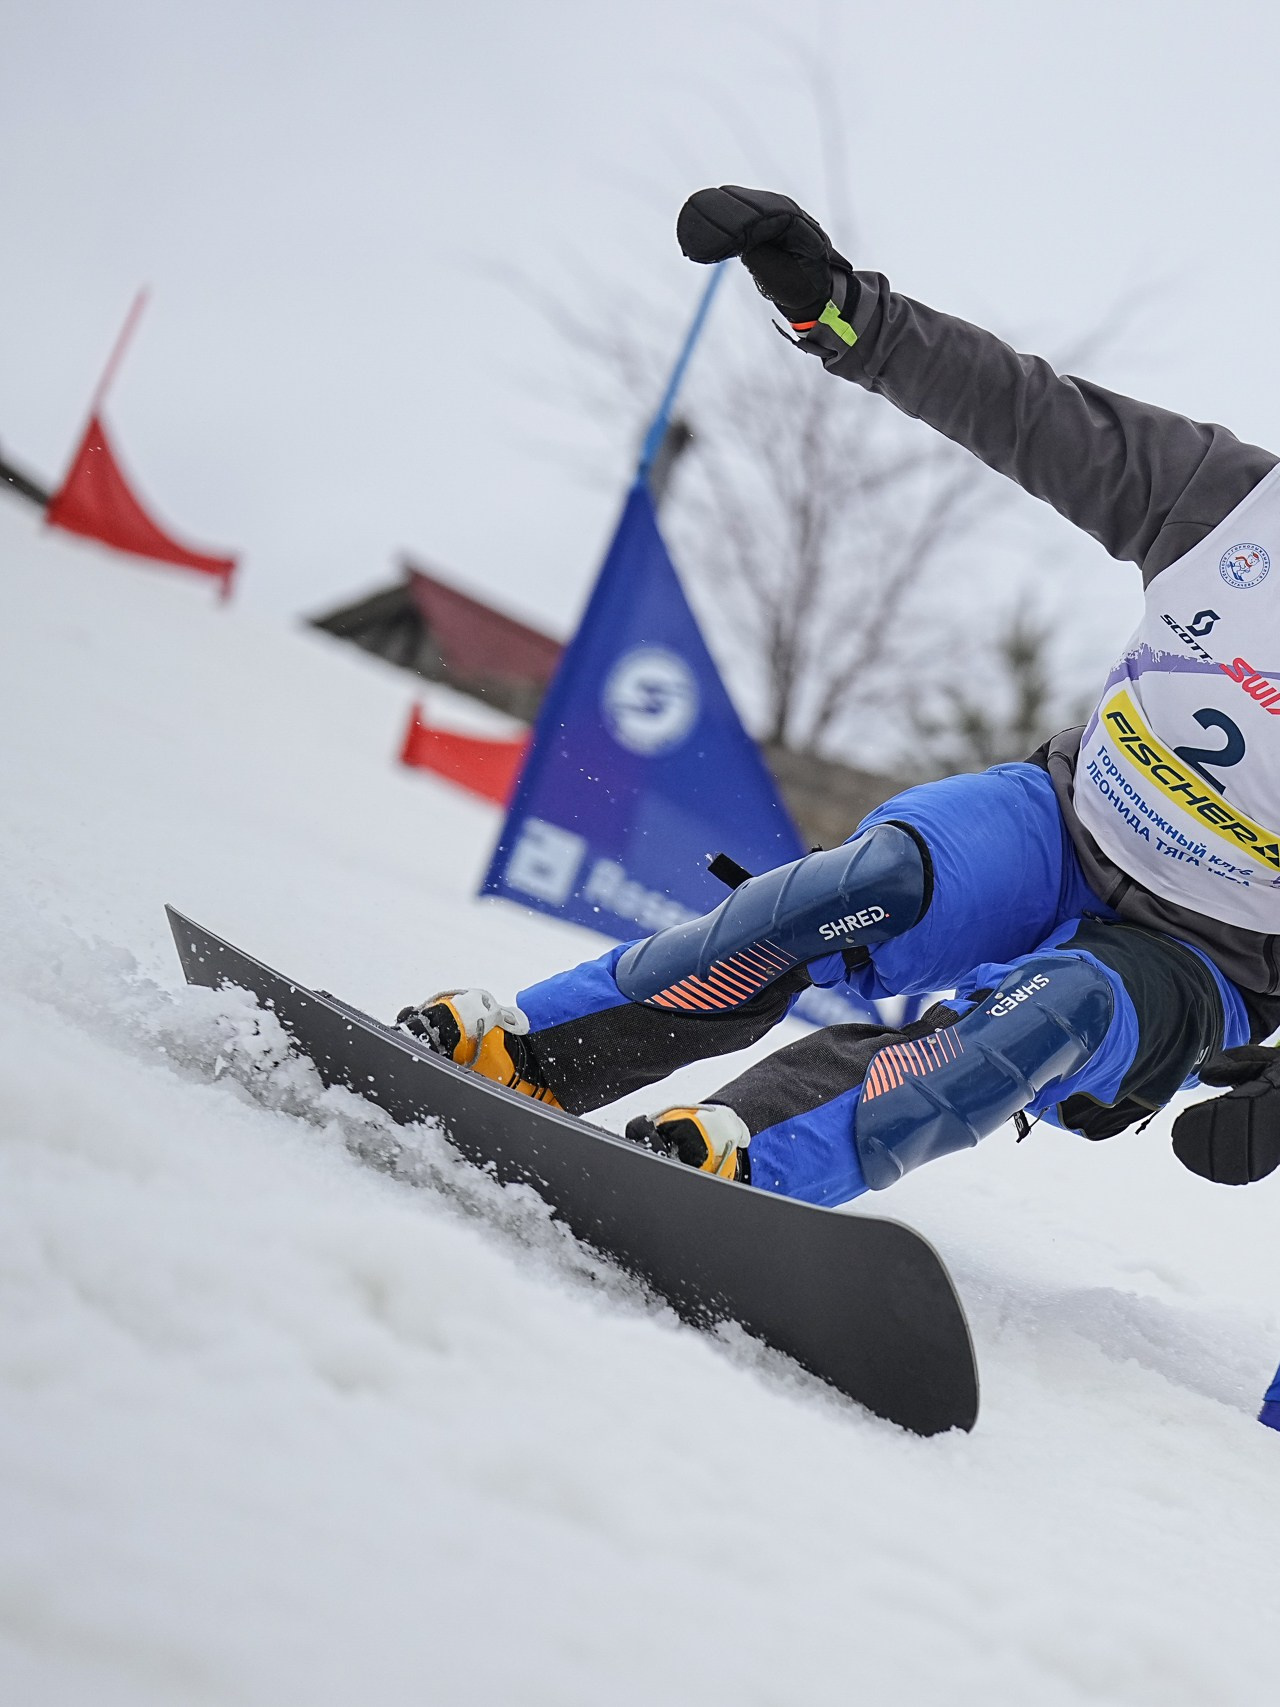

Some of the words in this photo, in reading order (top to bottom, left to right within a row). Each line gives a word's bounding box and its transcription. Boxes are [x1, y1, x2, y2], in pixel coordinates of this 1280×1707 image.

[1160, 614, 1213, 661] SCOTT
[1106, 711, 1258, 845] FISCHER
[1173, 708, 1246, 795] 2
[1087, 760, 1150, 842] ЛЕОНИДА
[1097, 745, 1207, 859] Горнолыжный
